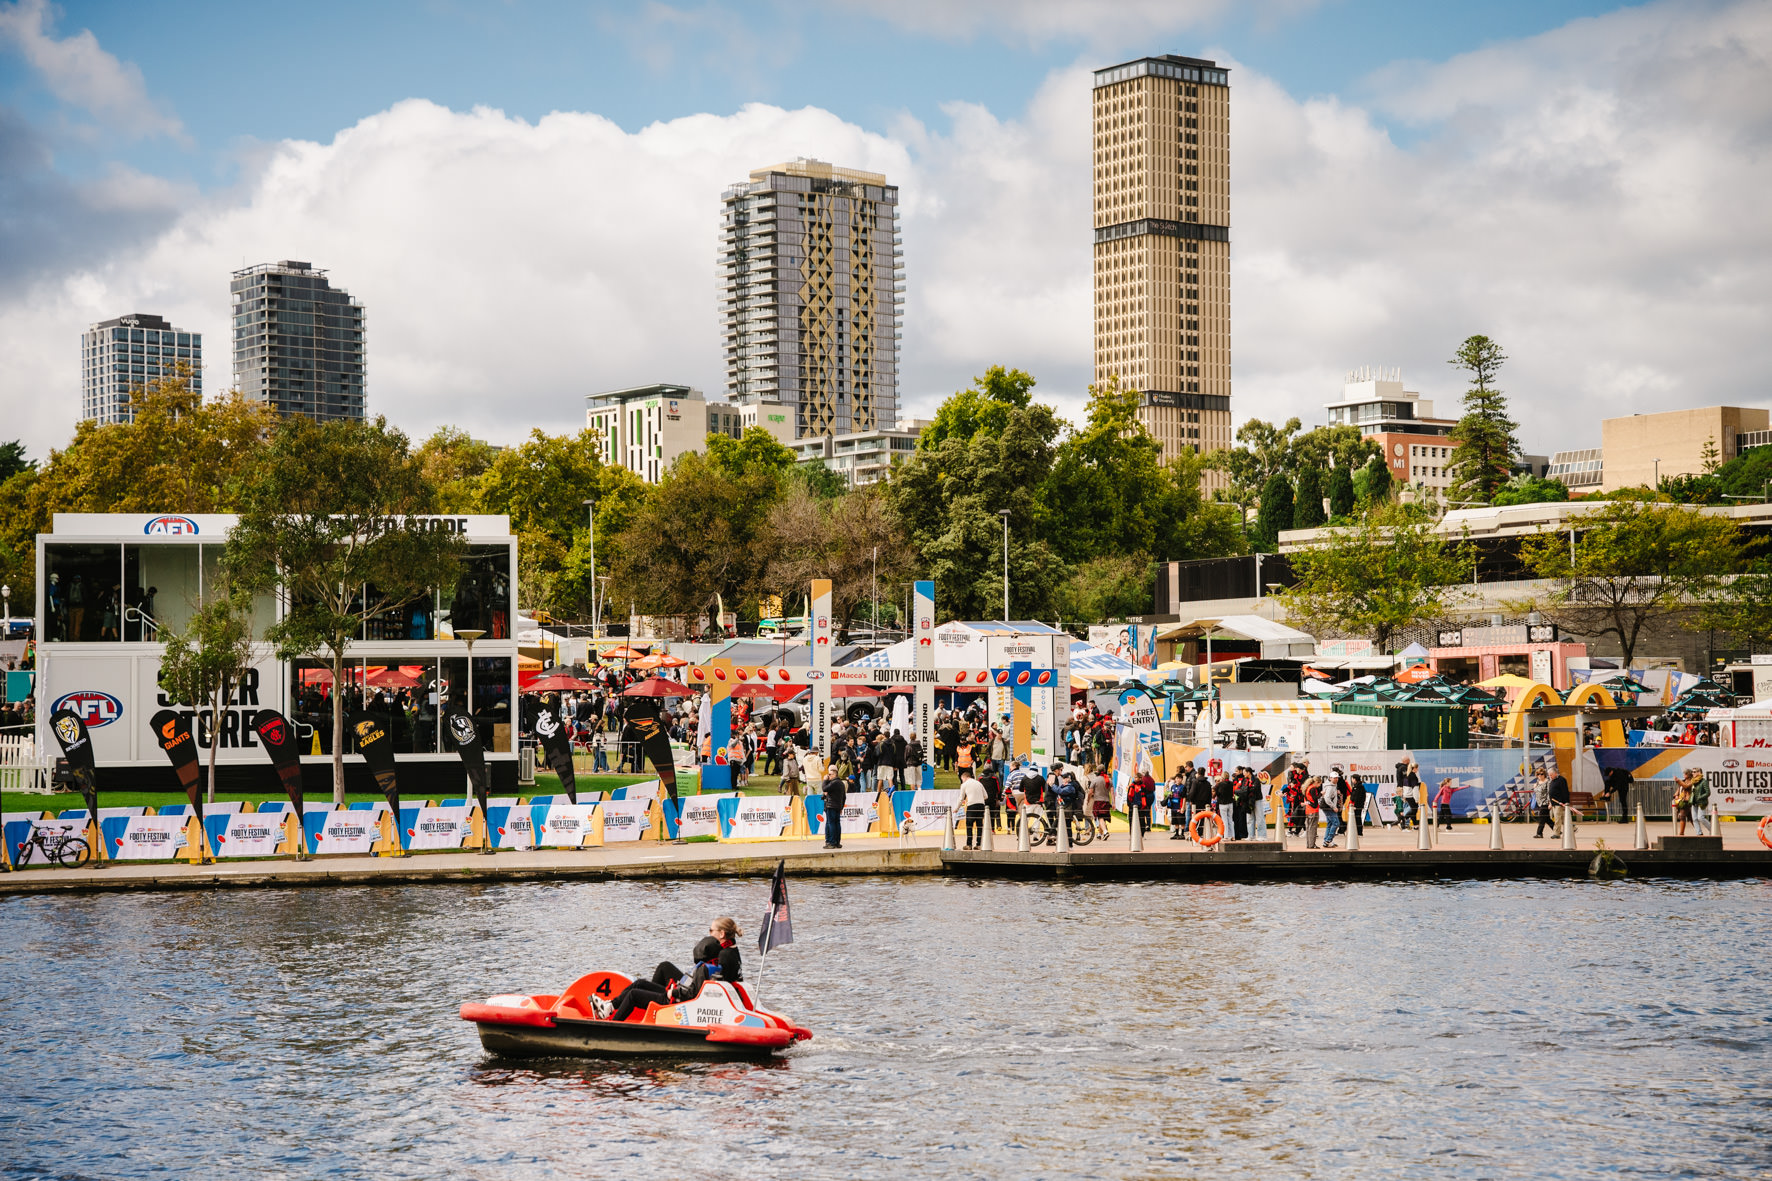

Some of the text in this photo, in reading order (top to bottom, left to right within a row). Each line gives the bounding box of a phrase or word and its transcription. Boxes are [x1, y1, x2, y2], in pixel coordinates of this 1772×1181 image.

[147, 520, 196, 535] AFL
[874, 670, 900, 682] FOOTY
[902, 670, 939, 682] FESTIVAL
[157, 668, 259, 707] SPER
[1132, 716, 1155, 724] ENTRY
[1137, 708, 1155, 716] FREE
[176, 710, 258, 748] TORE
[164, 731, 190, 750] GIANTS
[360, 730, 384, 748] EAGLES
[1706, 771, 1743, 788] FOOTY
[596, 978, 611, 997] 4
[697, 1008, 724, 1016] PADDLE
